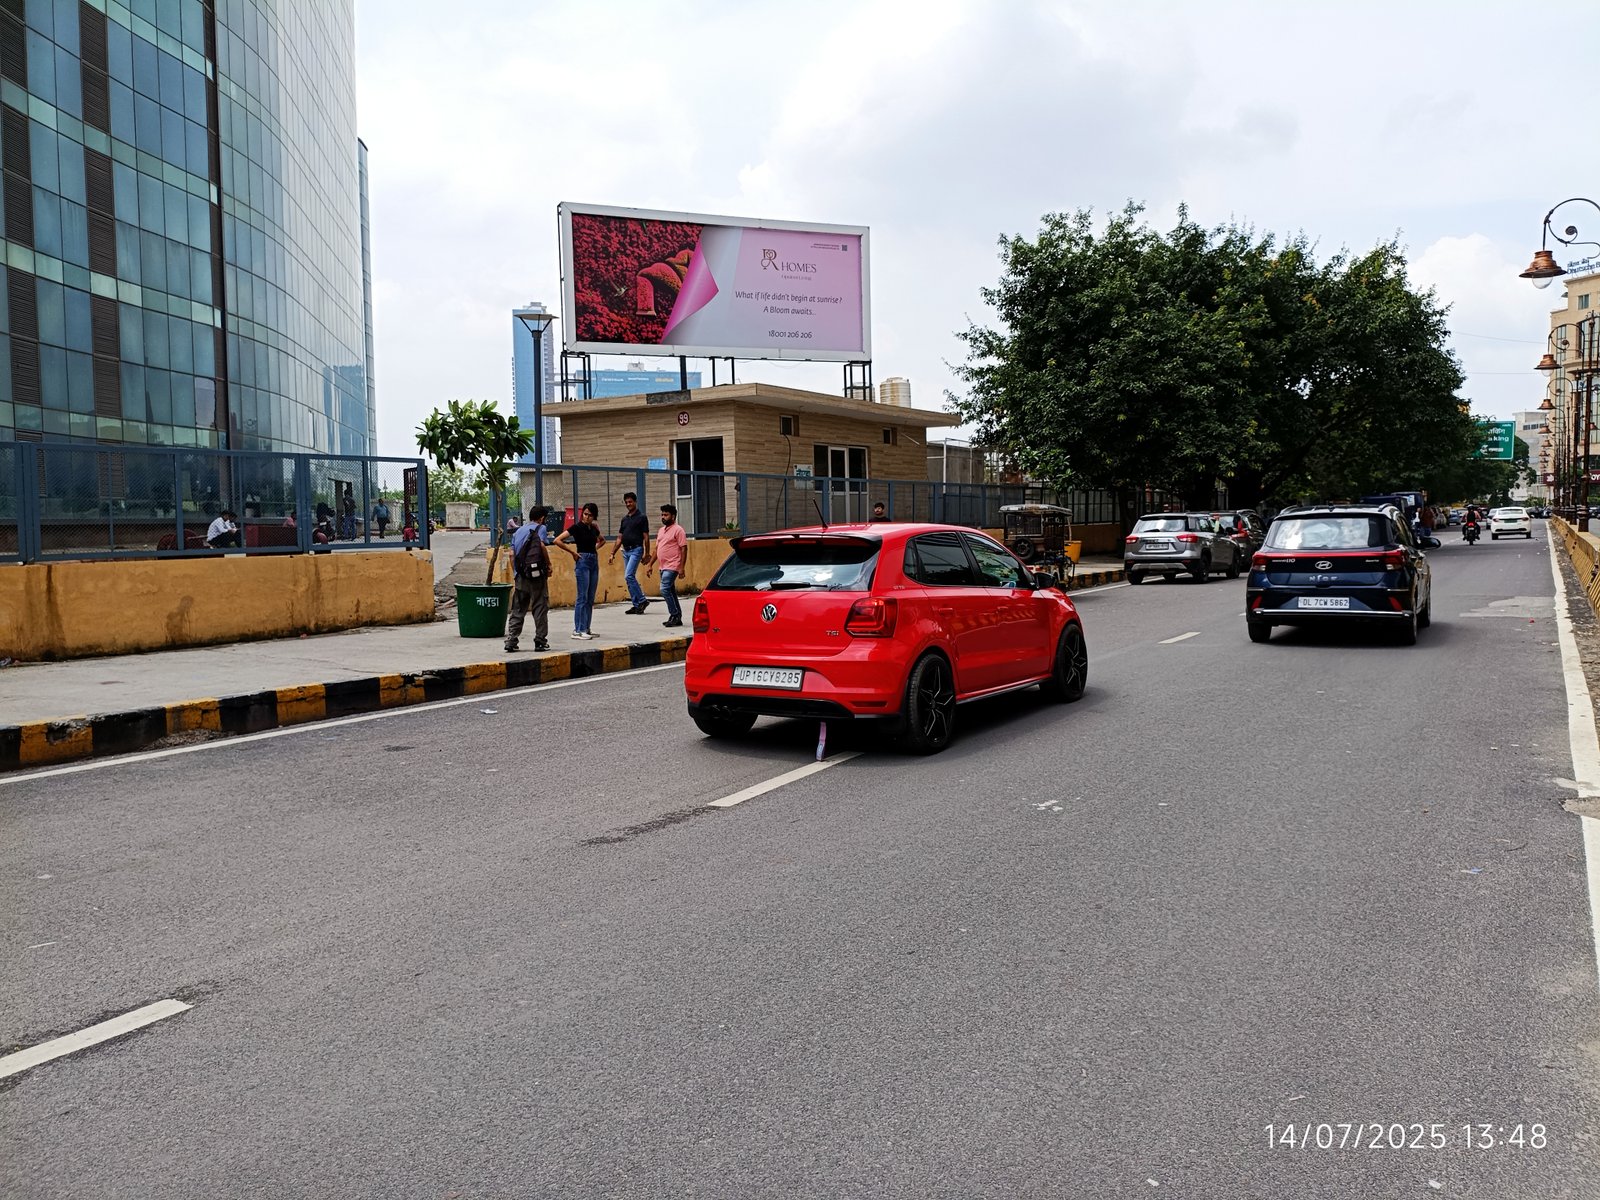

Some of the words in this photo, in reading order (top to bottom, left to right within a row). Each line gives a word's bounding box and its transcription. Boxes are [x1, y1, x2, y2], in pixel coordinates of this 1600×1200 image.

[781, 261, 817, 273] HOMES
[735, 291, 753, 299] What
[754, 291, 760, 301] if
[761, 292, 771, 301] life
[771, 293, 790, 301] didn't
[791, 294, 808, 303] begin
[770, 306, 790, 314] Bloom
[768, 330, 787, 338] 18001
[800, 331, 813, 339] 206
[679, 413, 689, 424] 99
[1303, 598, 1312, 606] DL
